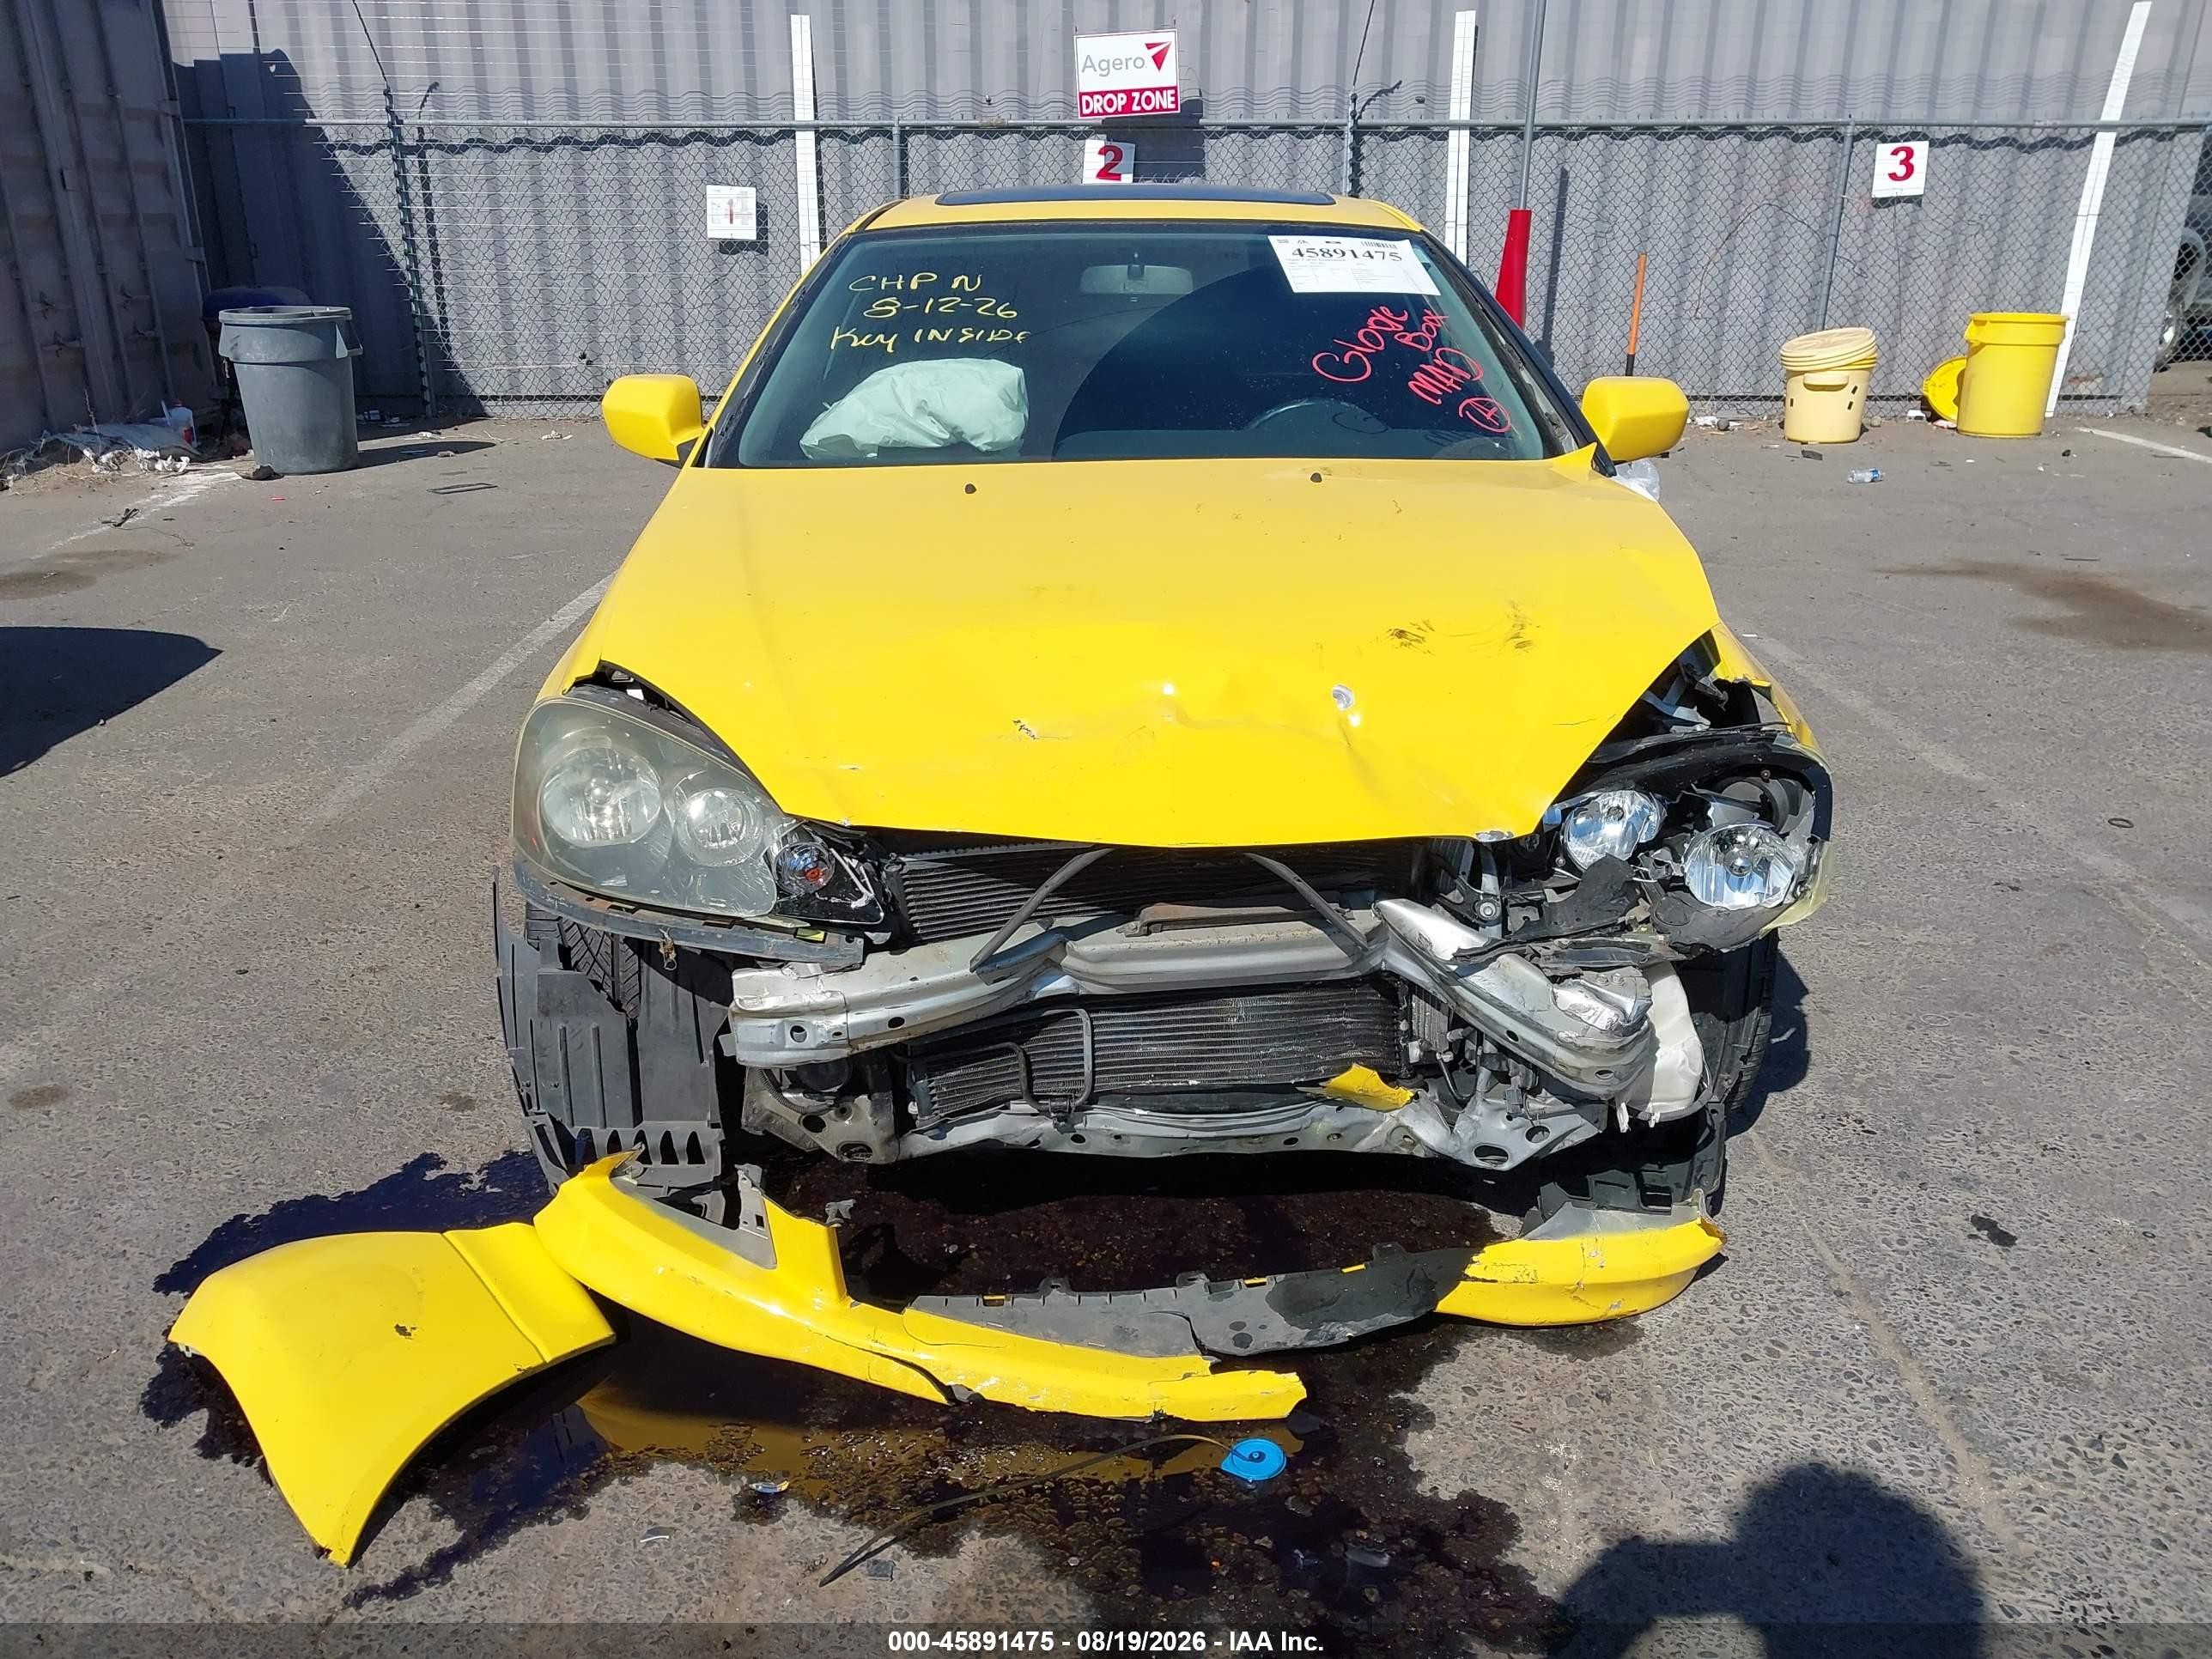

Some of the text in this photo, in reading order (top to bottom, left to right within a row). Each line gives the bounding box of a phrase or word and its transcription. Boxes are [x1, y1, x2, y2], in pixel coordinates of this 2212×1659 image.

[1081, 54, 1146, 77] Agero
[1082, 89, 1176, 114] DROP ZONE
[1096, 144, 1124, 181] 2
[1887, 146, 1915, 182] 3
[1291, 247, 1403, 261] 45891475
[848, 272, 982, 291] CHP N
[862, 296, 1018, 319] 8-12-26
